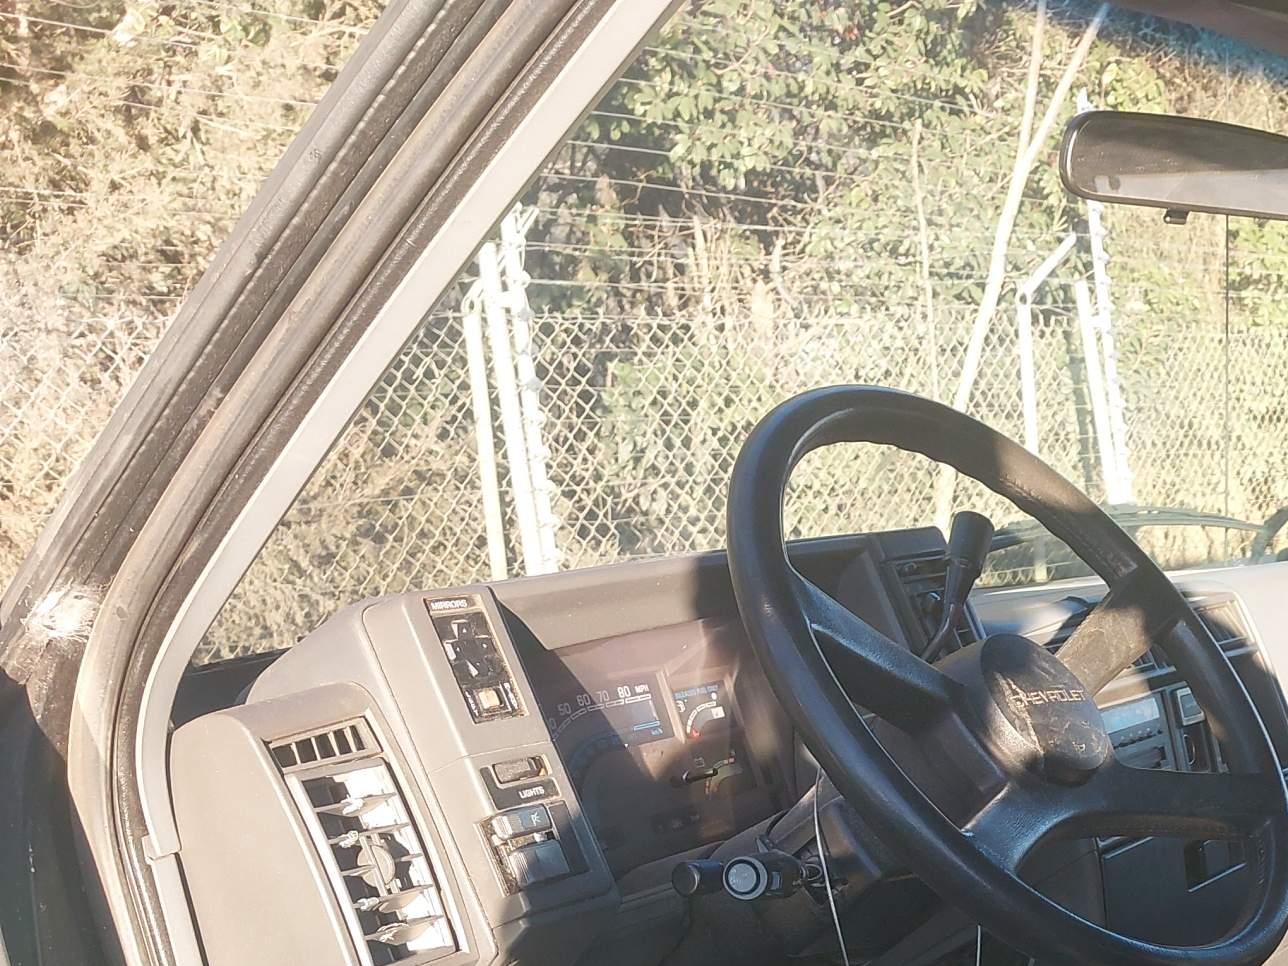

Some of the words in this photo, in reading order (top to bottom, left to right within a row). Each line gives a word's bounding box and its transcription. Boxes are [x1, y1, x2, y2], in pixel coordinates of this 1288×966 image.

[430, 600, 468, 610] MIRRORS
[617, 685, 631, 698] 80
[634, 684, 650, 694] MPH
[576, 693, 591, 706] 60
[596, 690, 610, 703] 70
[1009, 689, 1086, 707] CHEVROLET
[557, 702, 572, 715] 50
[518, 785, 545, 799] LIGHTS
